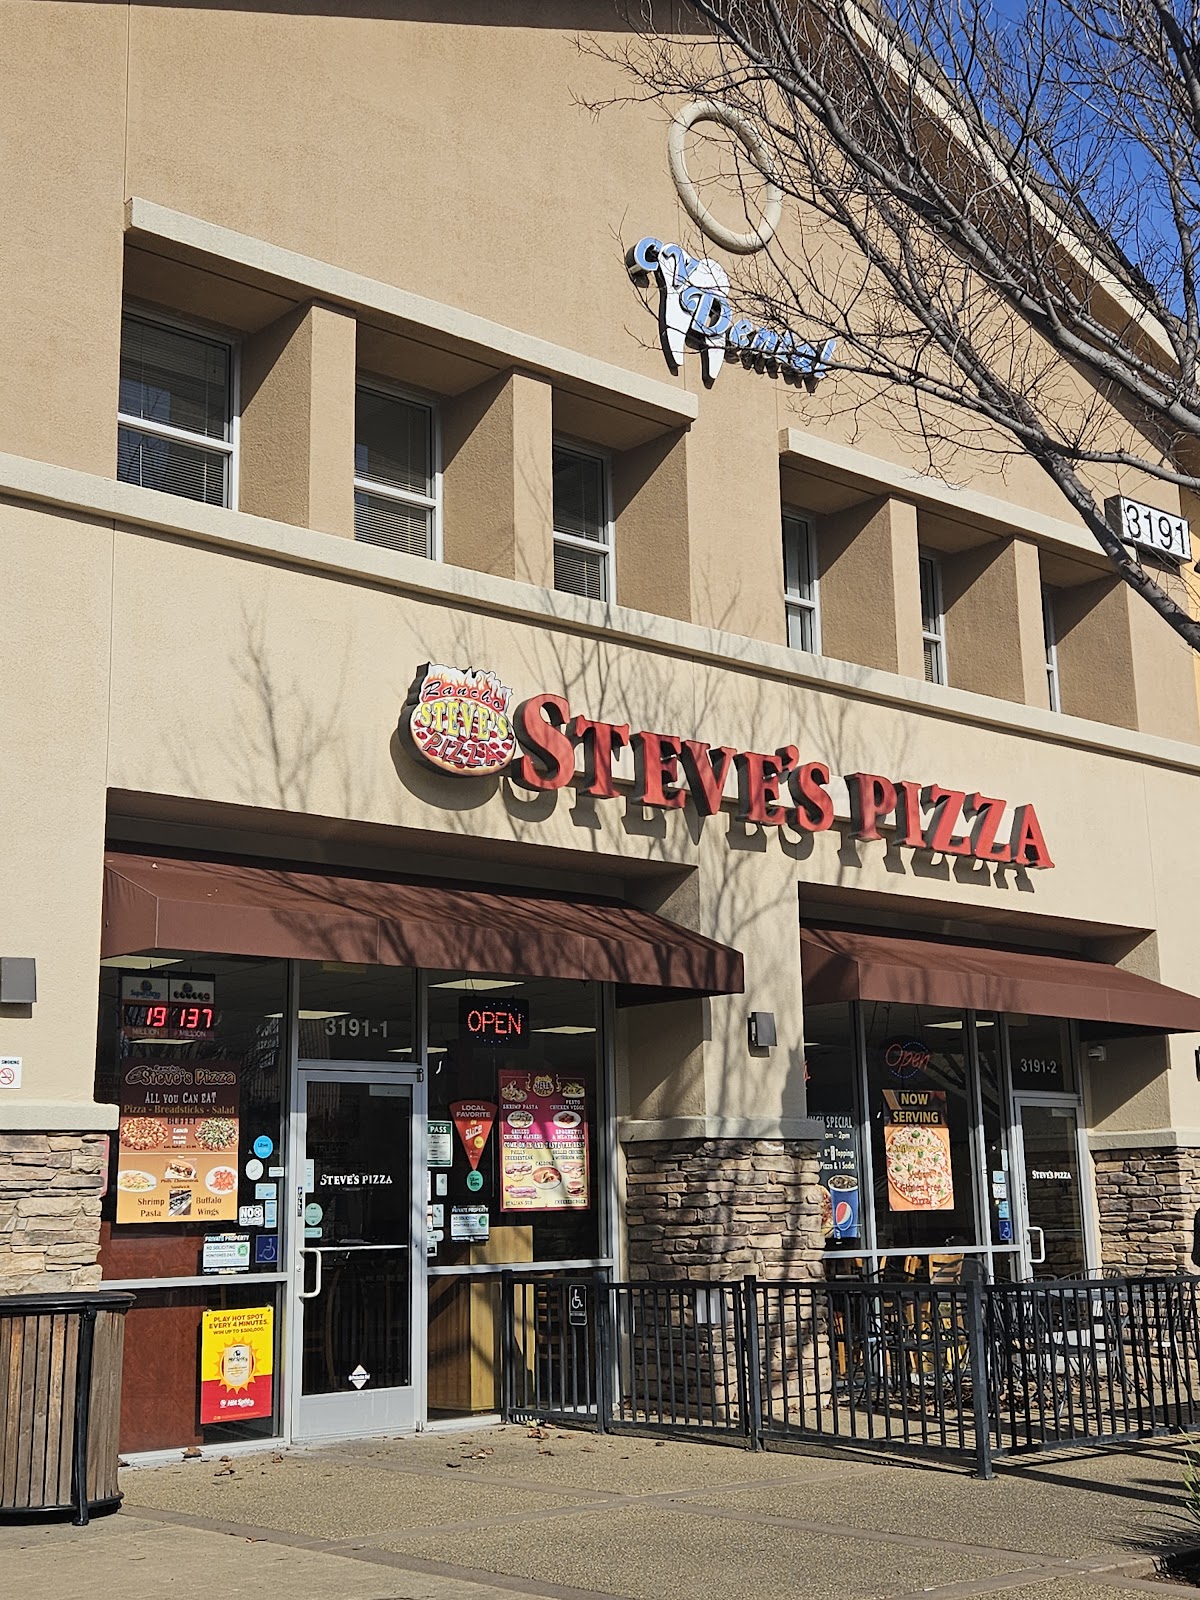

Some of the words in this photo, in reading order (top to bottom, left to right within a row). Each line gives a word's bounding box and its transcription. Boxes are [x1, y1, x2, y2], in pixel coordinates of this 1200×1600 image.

[1126, 504, 1185, 555] 3191
[423, 680, 504, 710] Rancho
[419, 701, 509, 742] STEVE'S
[422, 732, 505, 767] PIZZA
[514, 693, 836, 833] STEVE'S
[845, 772, 1055, 870] PIZZA
[146, 1006, 167, 1027] 19
[179, 1007, 213, 1029] 137
[467, 1009, 522, 1035] OPEN
[324, 1017, 389, 1038] 3191-1
[885, 1043, 931, 1073] Open
[1020, 1058, 1058, 1075] 3191-2
[141, 1068, 194, 1085] Steve's
[194, 1068, 237, 1085] Pizza
[144, 1091, 160, 1104] ALL
[201, 1092, 217, 1104] EAT
[901, 1093, 929, 1106] NOW
[123, 1104, 147, 1113] Pizza
[154, 1105, 205, 1114] Breadsticks
[211, 1106, 235, 1114] Salad
[167, 1117, 197, 1125] BUFFET
[826, 1115, 853, 1128] SPECIAL
[892, 1110, 940, 1124] SERVING
[838, 1131, 851, 1140] 2pm
[835, 1148, 855, 1159] Topping
[842, 1161, 855, 1170] Soda
[320, 1173, 360, 1186] STEVE'S
[361, 1174, 393, 1185] PIZZA
[1031, 1169, 1054, 1180] STEVE'S
[1054, 1171, 1072, 1180] PIZZA
[137, 1197, 165, 1207] Shrimp
[140, 1209, 162, 1217] Pasta
[197, 1208, 220, 1216] Wings
[240, 1208, 253, 1219] NO
